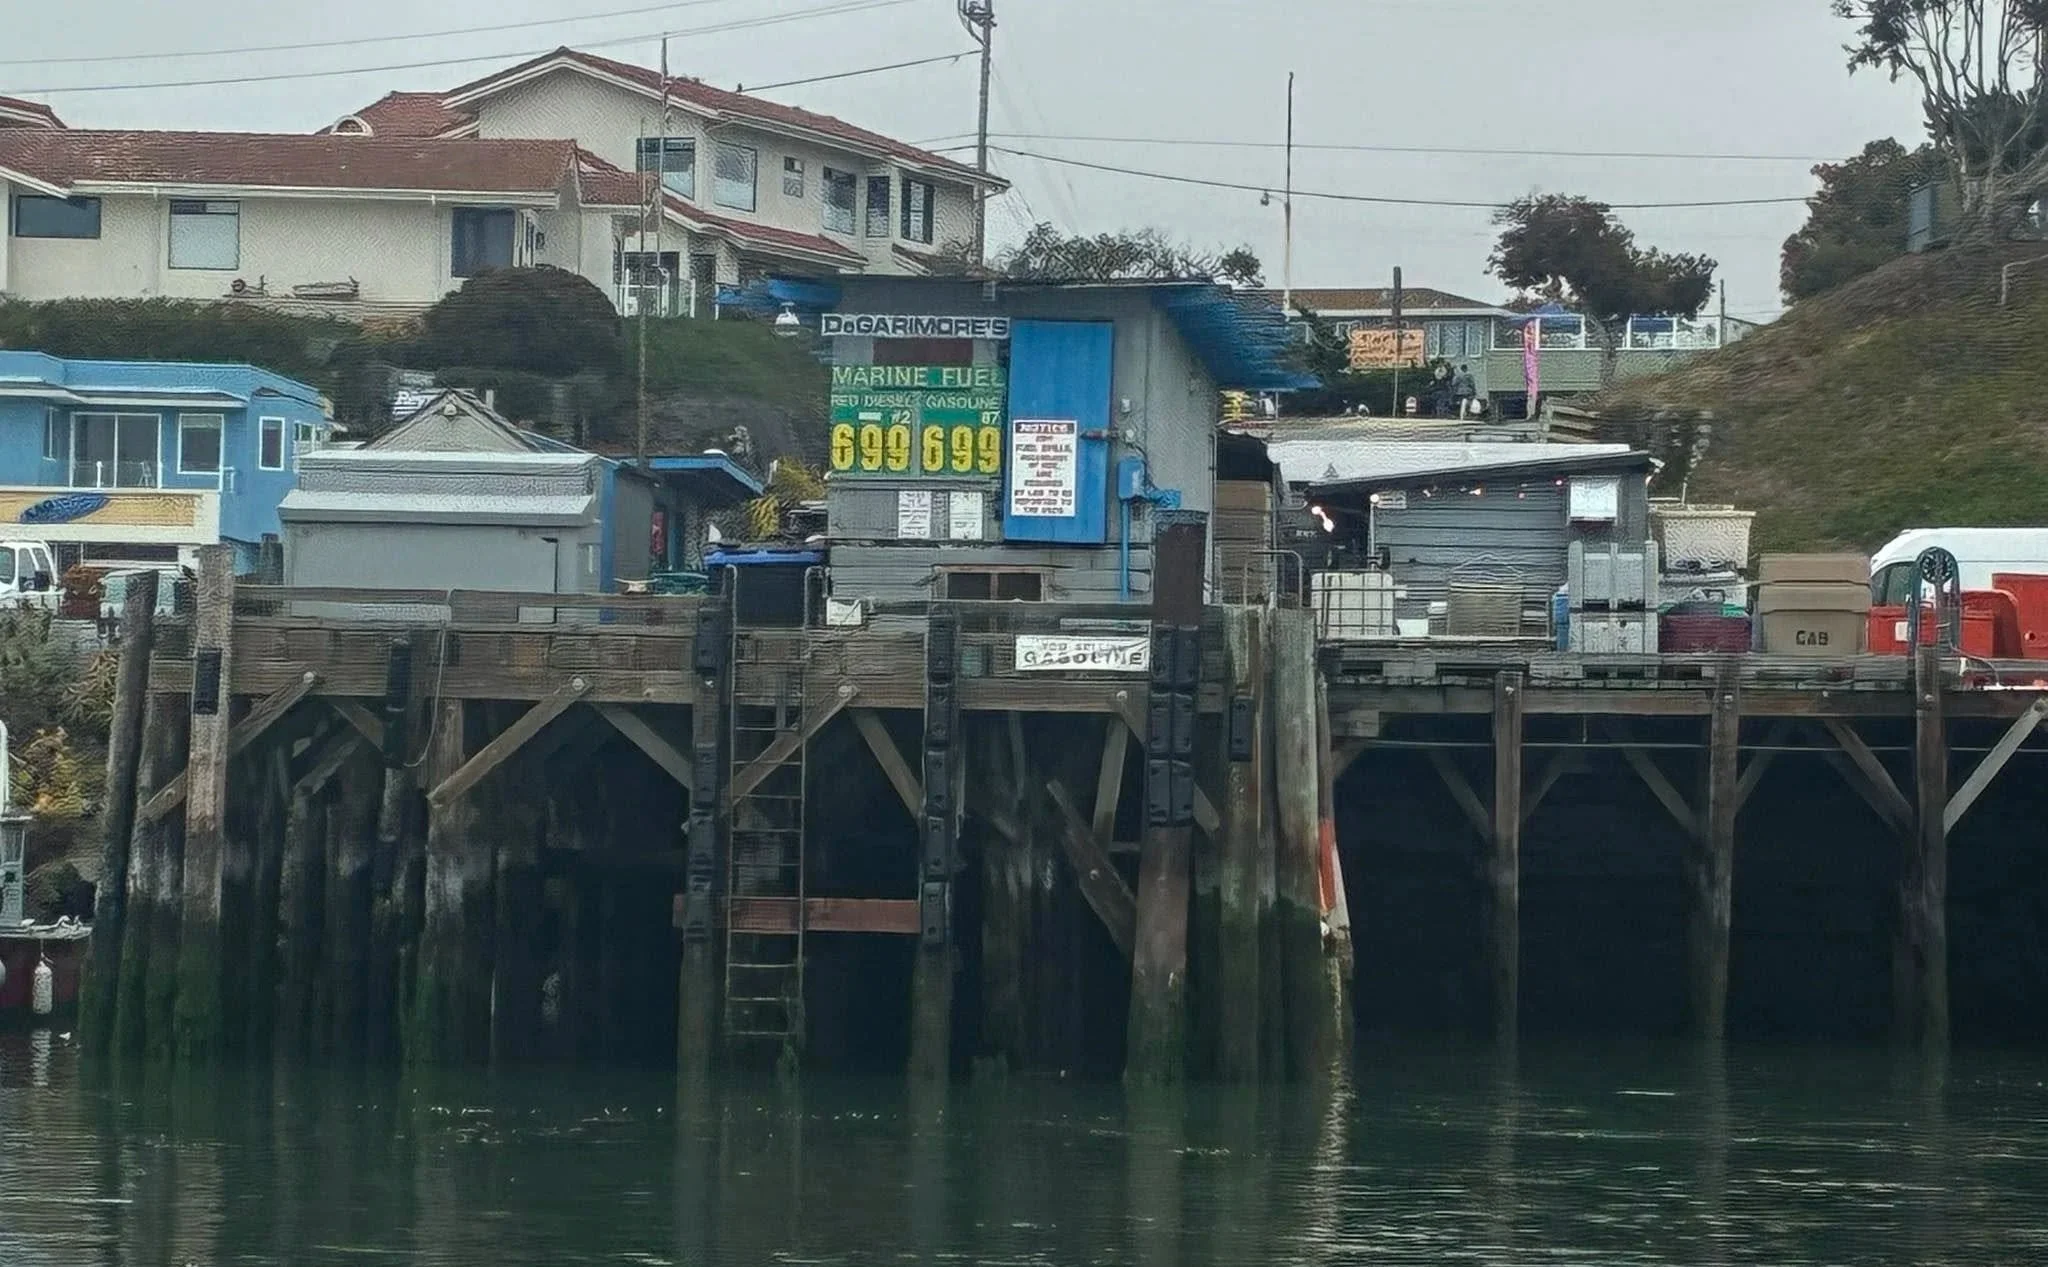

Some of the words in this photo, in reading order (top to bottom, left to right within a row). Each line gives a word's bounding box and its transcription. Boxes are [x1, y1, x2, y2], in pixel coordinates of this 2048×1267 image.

[832, 366, 929, 386] MARINE
[942, 366, 1006, 387] FUEL
[926, 396, 1000, 410] GASOLINE
[981, 411, 1001, 424] 87
[1019, 423, 1069, 433] NOTICE
[831, 423, 911, 471] 699
[922, 424, 1001, 473] 699
